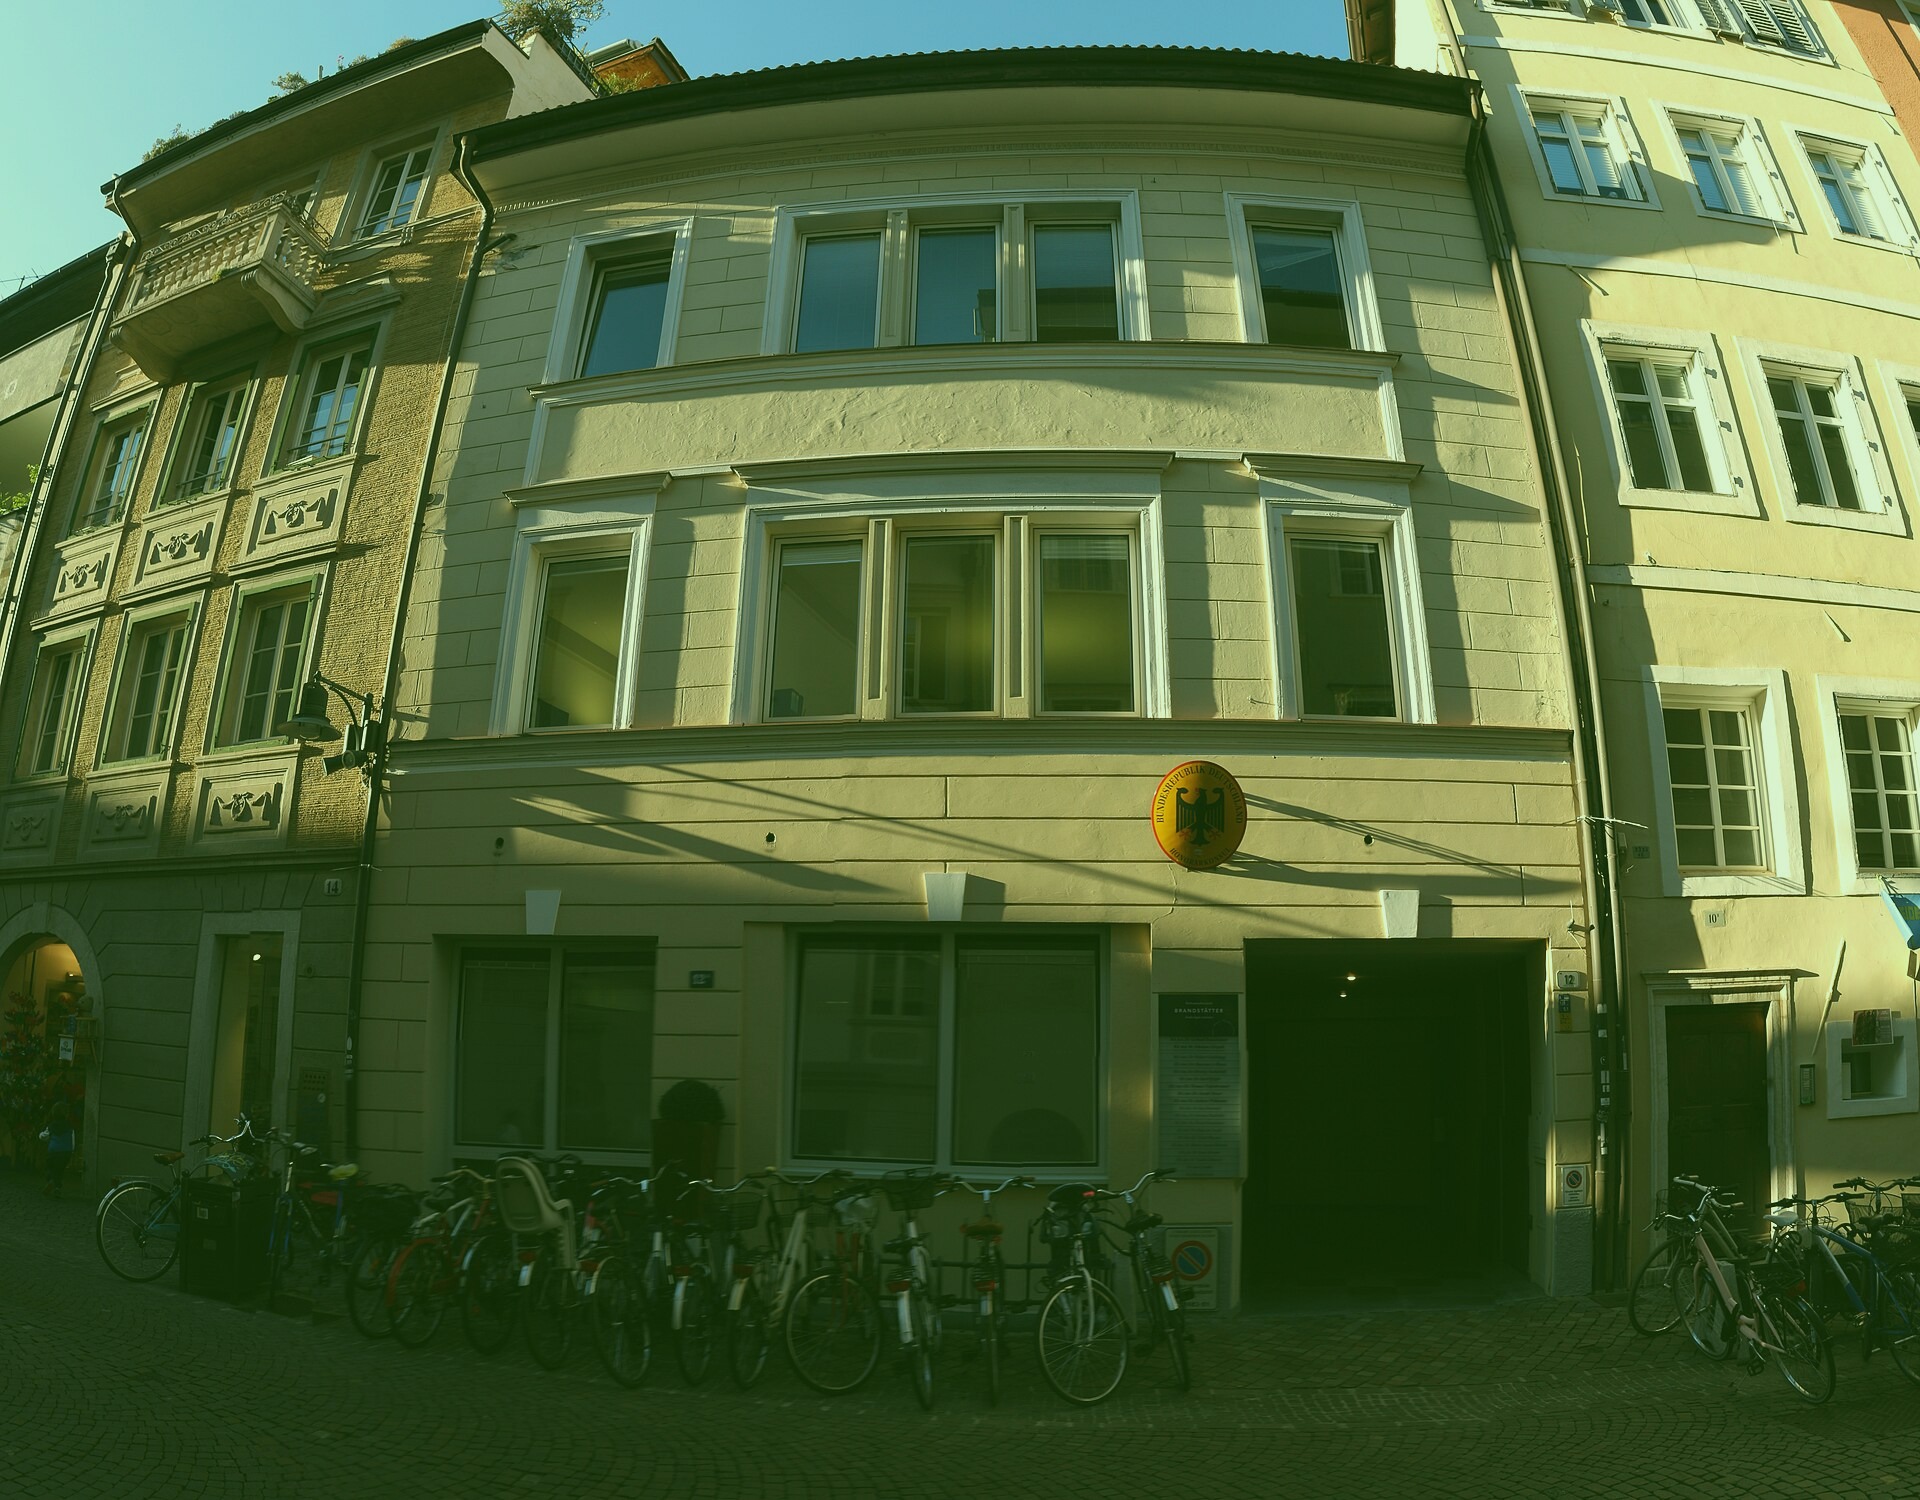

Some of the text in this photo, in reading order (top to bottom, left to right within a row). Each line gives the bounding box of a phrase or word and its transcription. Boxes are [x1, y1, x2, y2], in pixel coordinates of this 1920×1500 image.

[1156, 765, 1243, 824] BUNDESREPUBLIK DEUTSCHLAND
[1169, 847, 1232, 866] HONORARKONSUL
[326, 880, 339, 894] 14
[1564, 974, 1574, 985] 12
